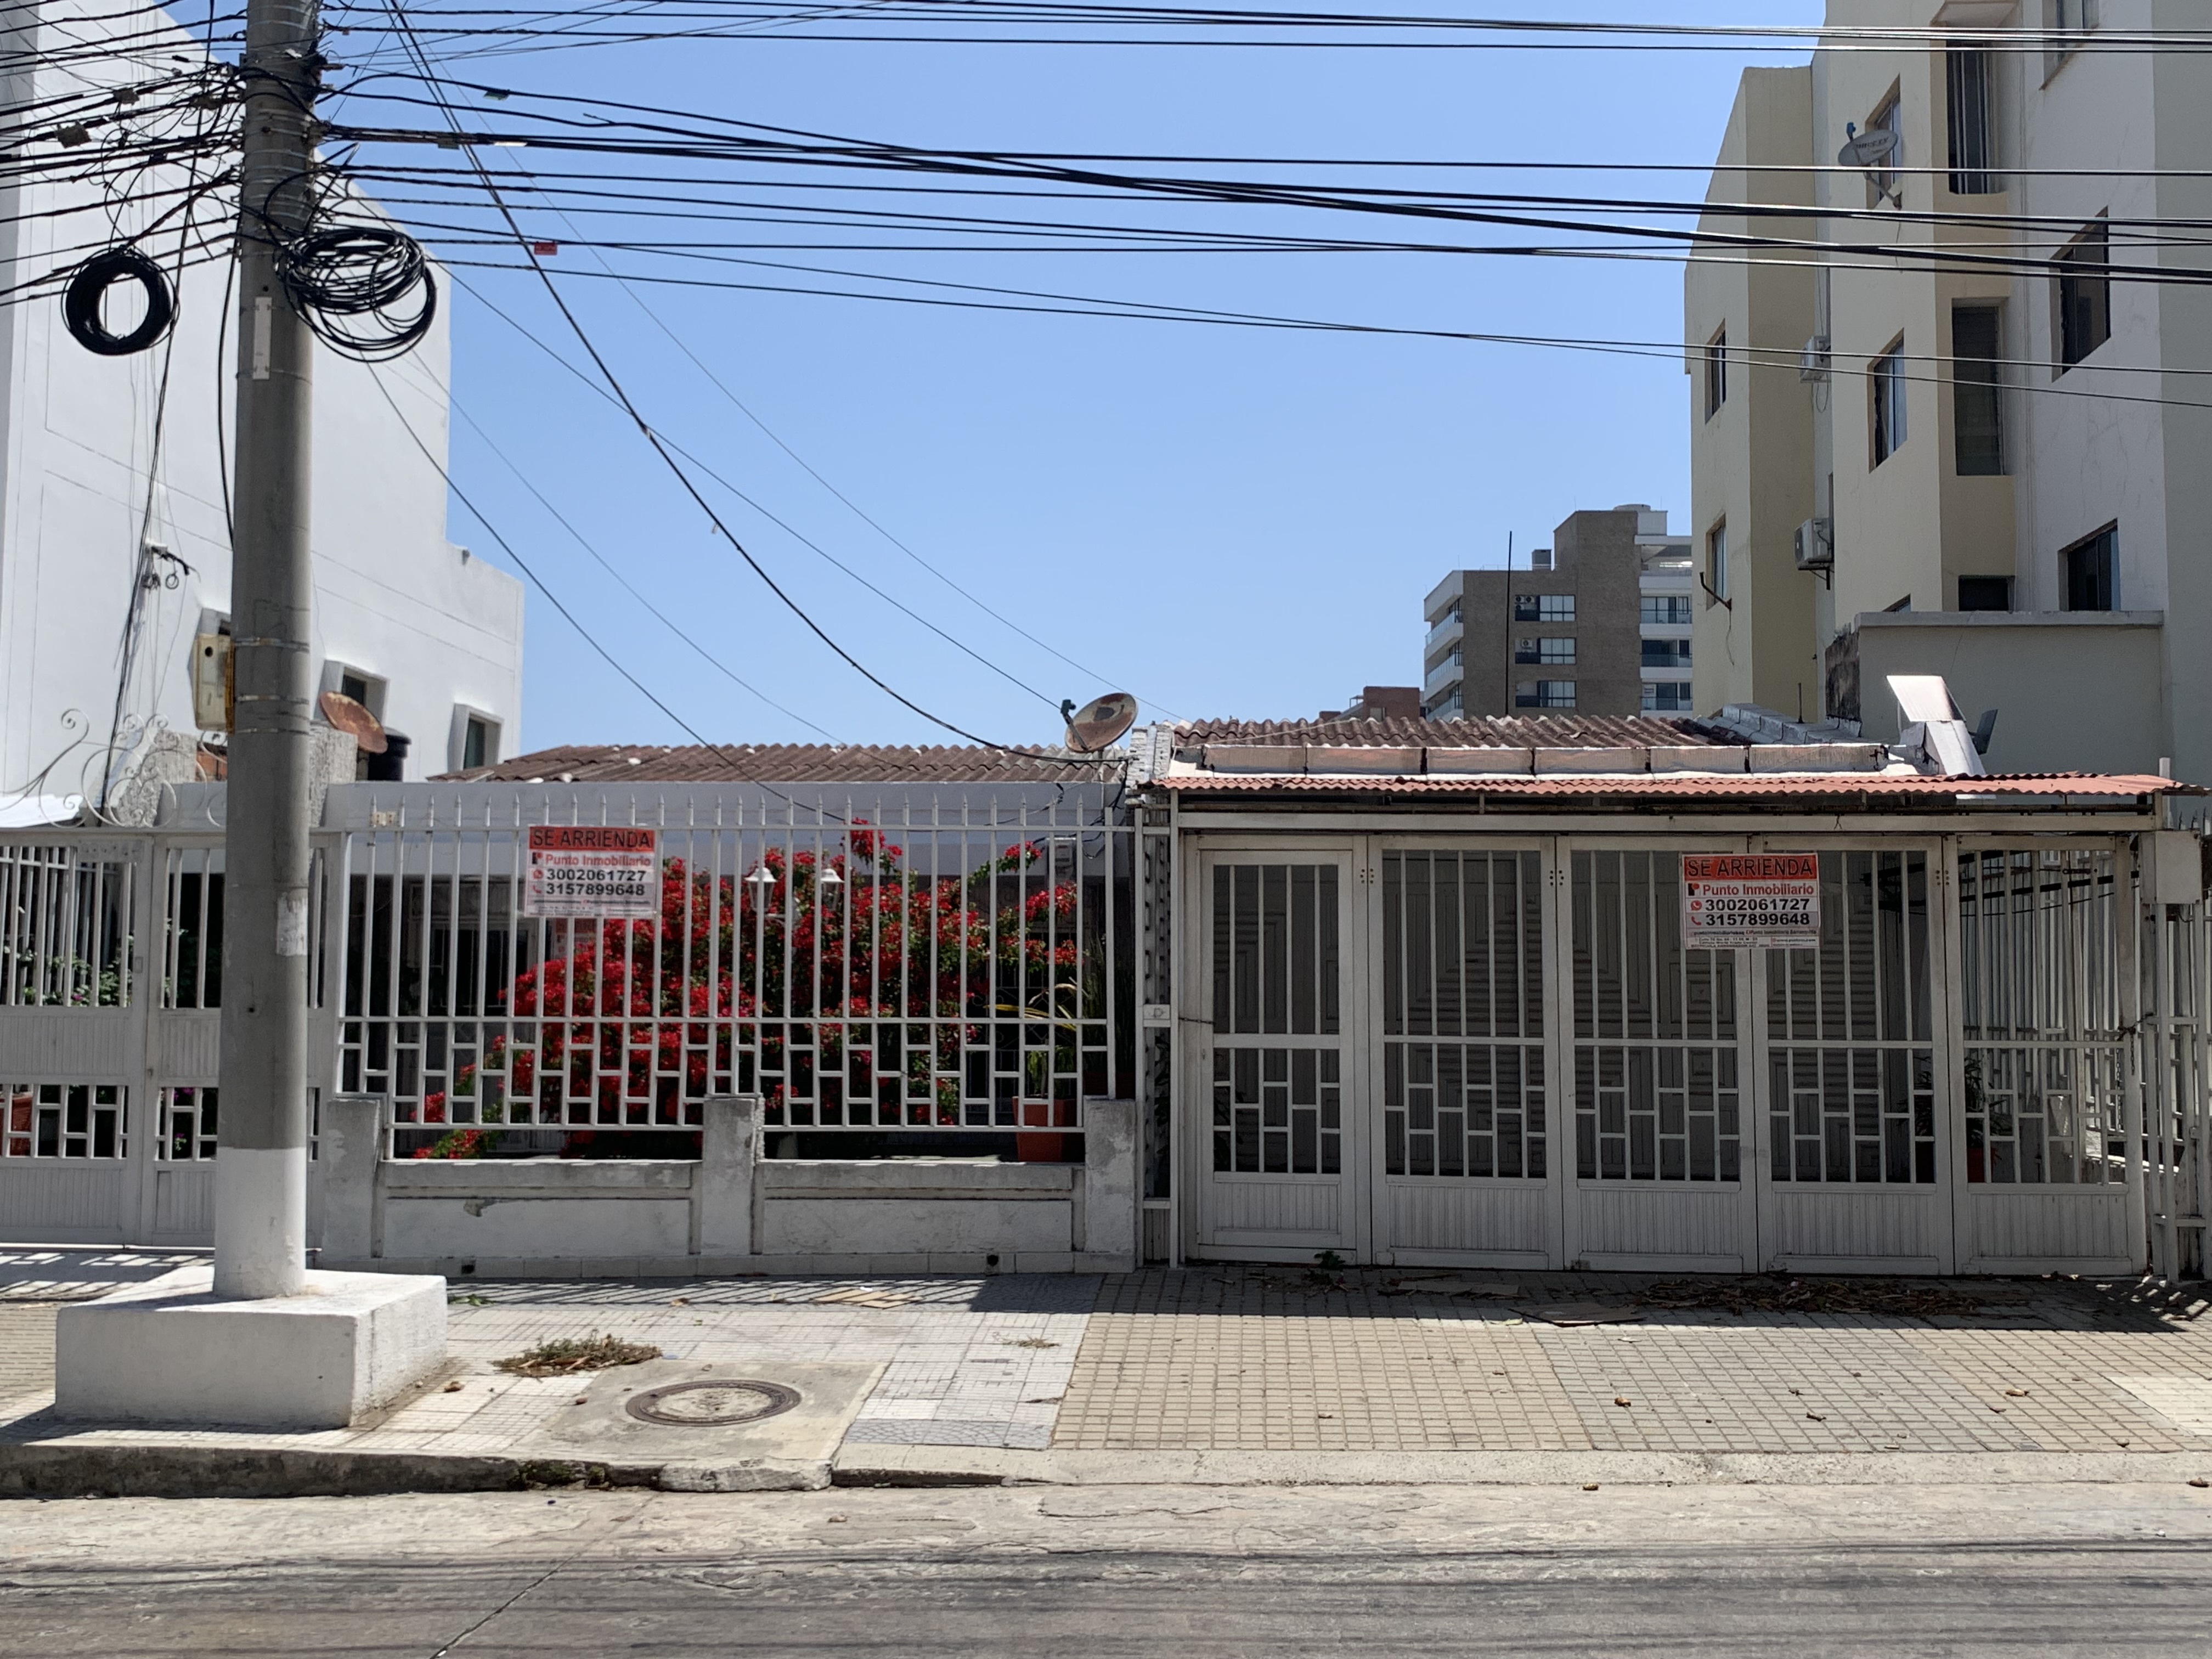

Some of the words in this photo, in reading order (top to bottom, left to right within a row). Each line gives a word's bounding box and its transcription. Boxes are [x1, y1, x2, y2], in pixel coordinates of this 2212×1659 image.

[533, 829, 554, 846] SE
[560, 830, 651, 848] ARRIENDA
[545, 855, 579, 866] Punto
[583, 855, 651, 866] Inmobiliario
[1688, 859, 1712, 876] SE
[1717, 859, 1813, 876] ARRIENDA
[546, 869, 647, 881] 3002061727
[545, 883, 645, 896] 3157899648
[1703, 884, 1739, 895] Punto
[1743, 883, 1814, 895] Inmobiliario
[1705, 898, 1810, 911] 3002061727
[1706, 913, 1810, 926] 3157899648
